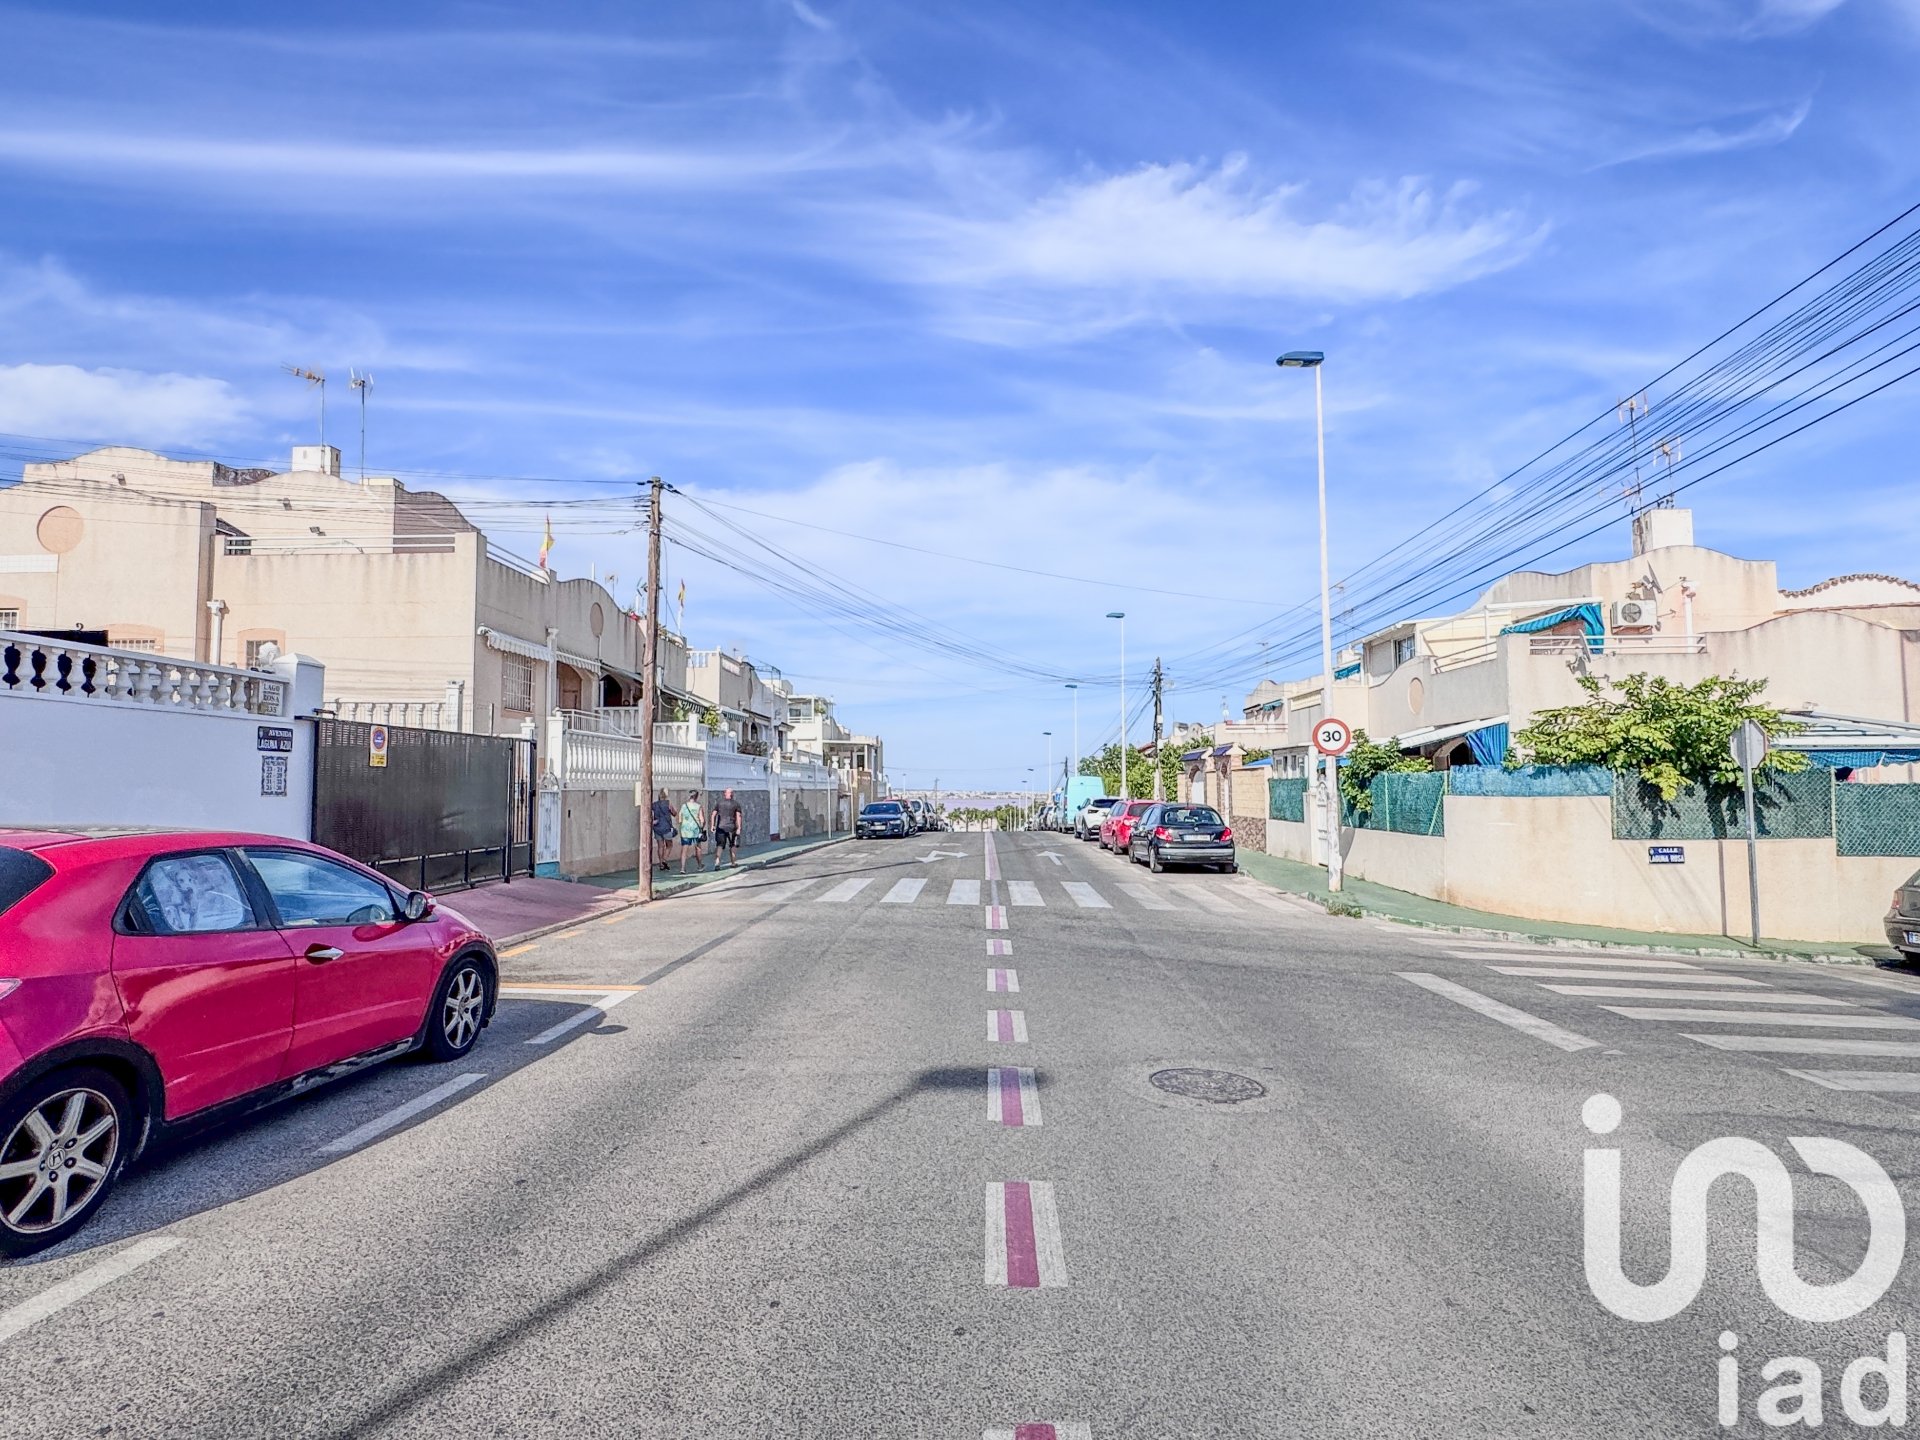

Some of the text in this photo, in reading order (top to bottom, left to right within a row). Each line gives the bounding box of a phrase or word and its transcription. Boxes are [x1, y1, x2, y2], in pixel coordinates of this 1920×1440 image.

[263, 683, 280, 692] LAGO
[268, 729, 292, 738] AVENIDA
[1322, 730, 1342, 742] 30
[258, 739, 292, 750] LAGUNA AZUL
